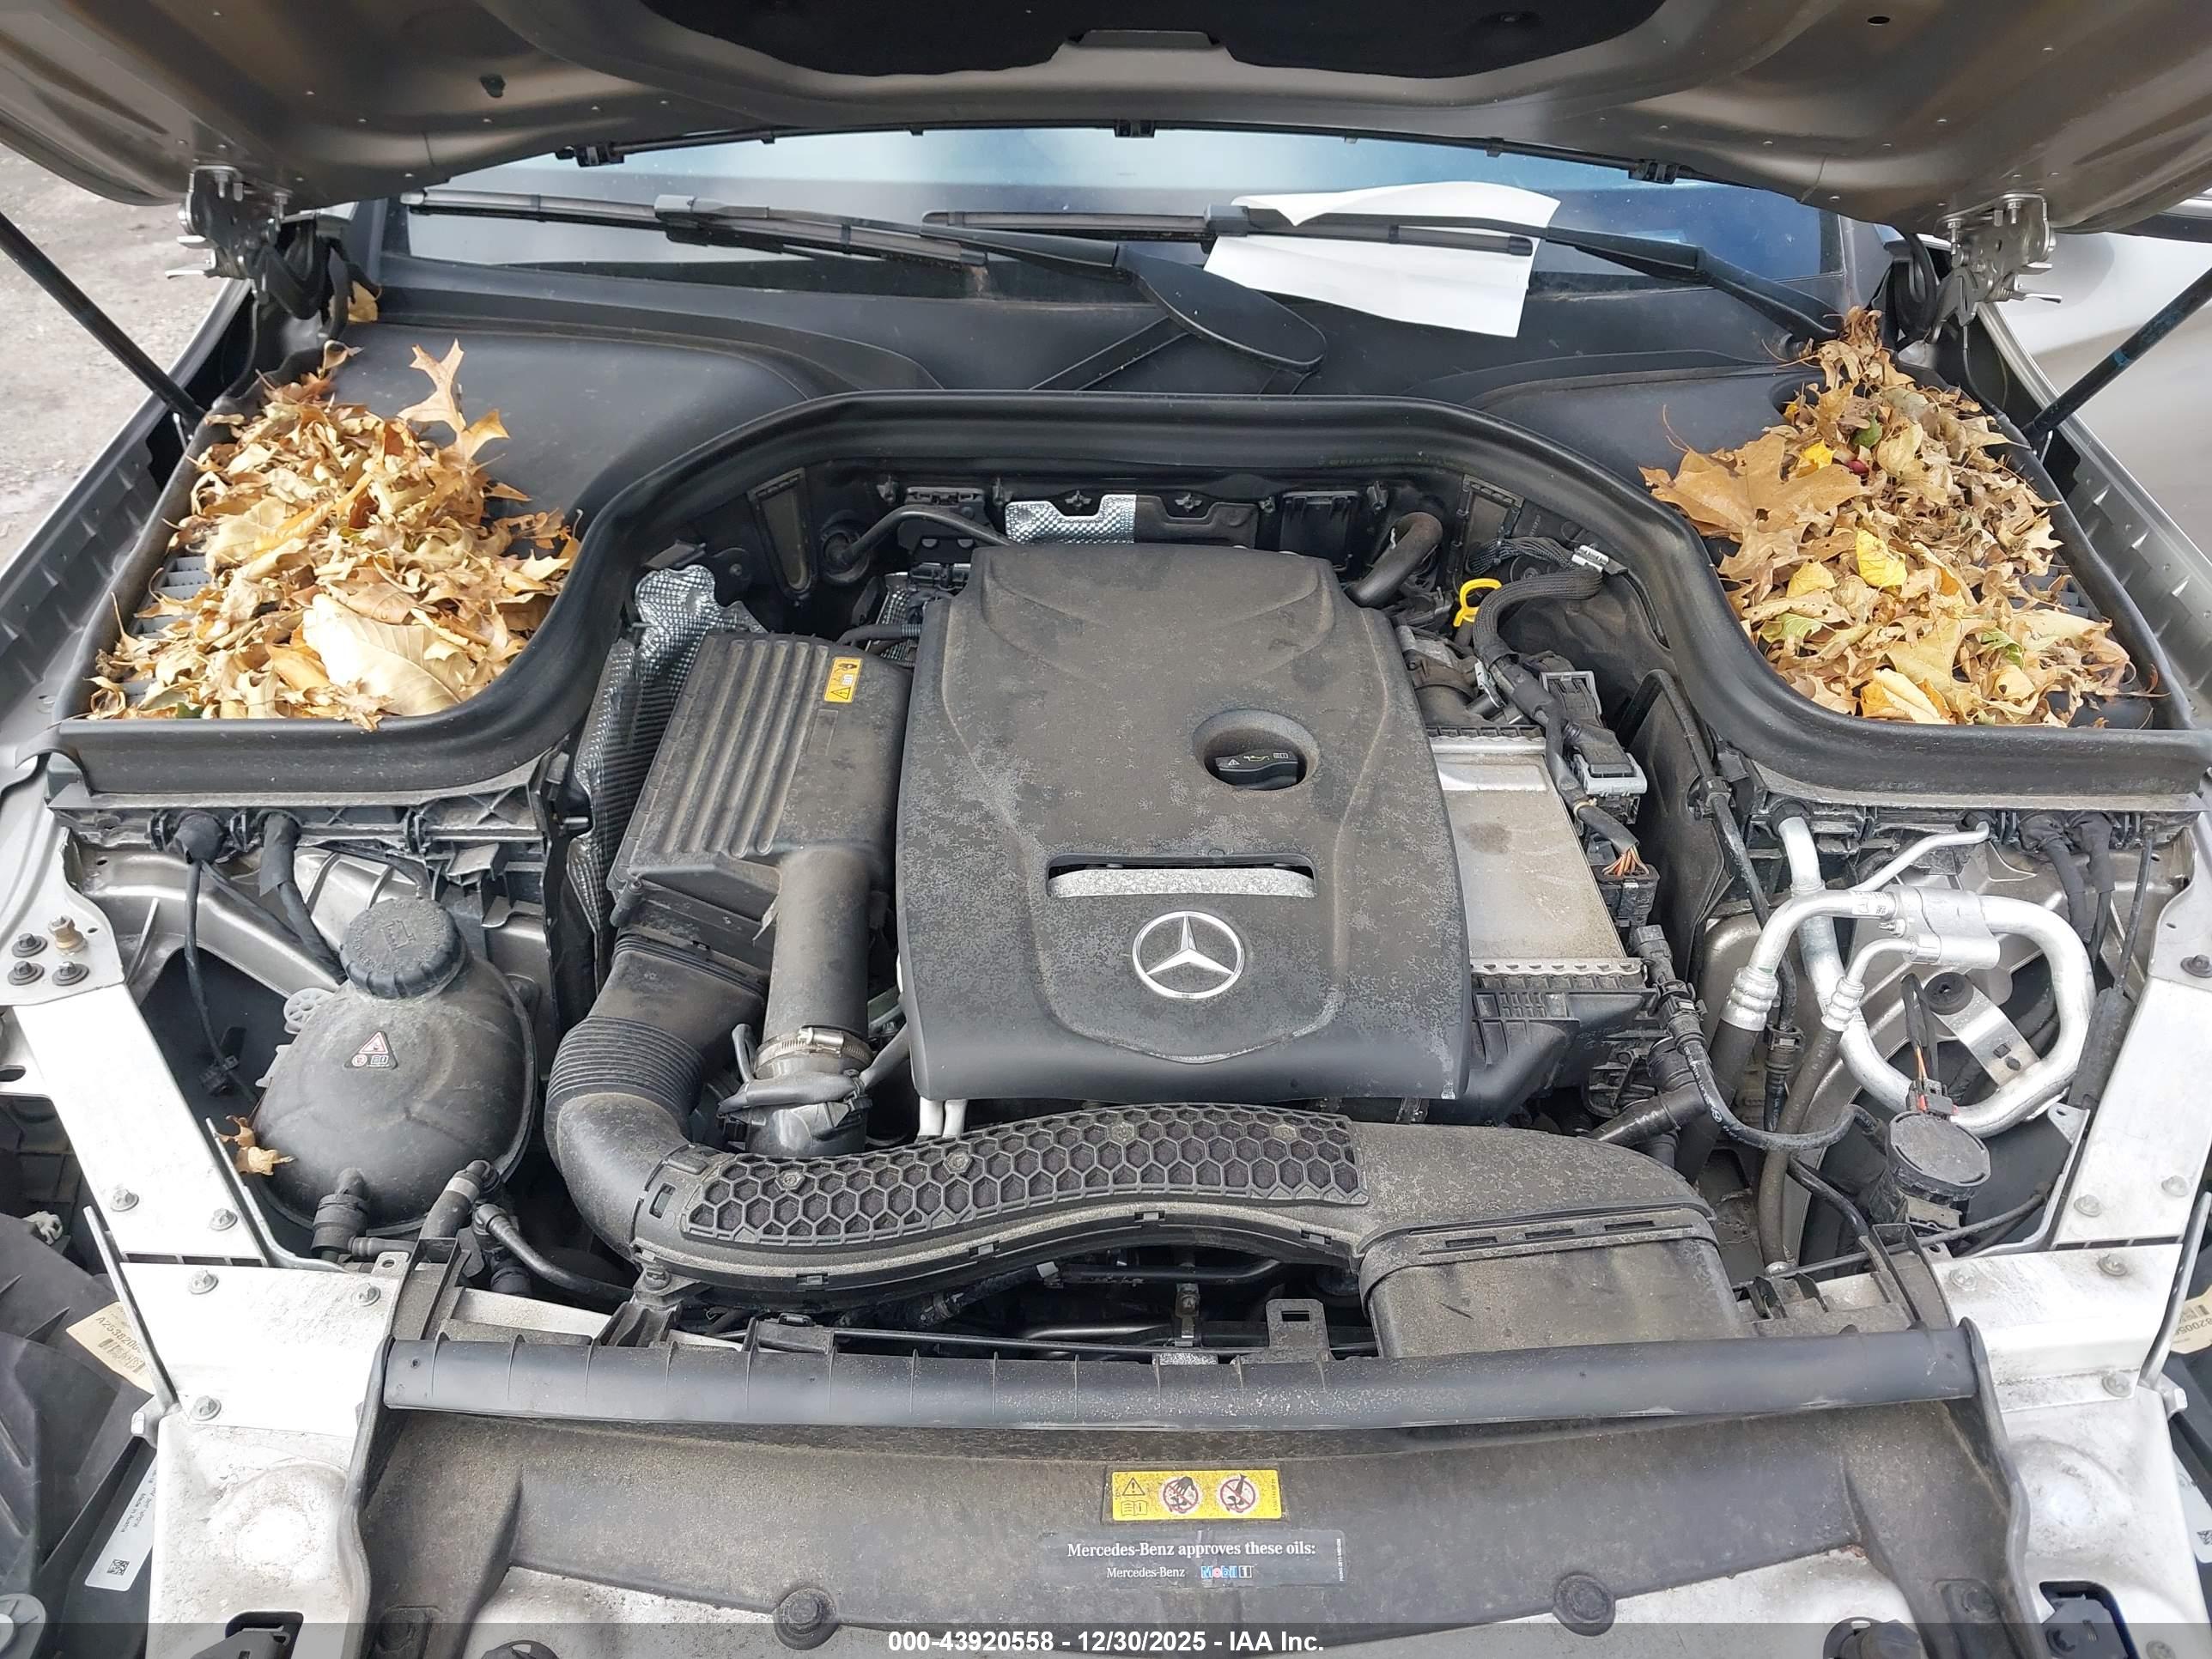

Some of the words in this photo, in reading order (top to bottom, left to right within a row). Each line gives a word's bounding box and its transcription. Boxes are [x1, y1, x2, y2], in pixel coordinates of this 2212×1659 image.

[1067, 1542, 1175, 1558] Mercedes-Benz
[1177, 1543, 1242, 1559] approves
[1244, 1541, 1283, 1555] these
[1285, 1541, 1316, 1555] oils:
[1106, 1566, 1186, 1578] Mercedes-Benz
[1201, 1565, 1237, 1579] Mobil
